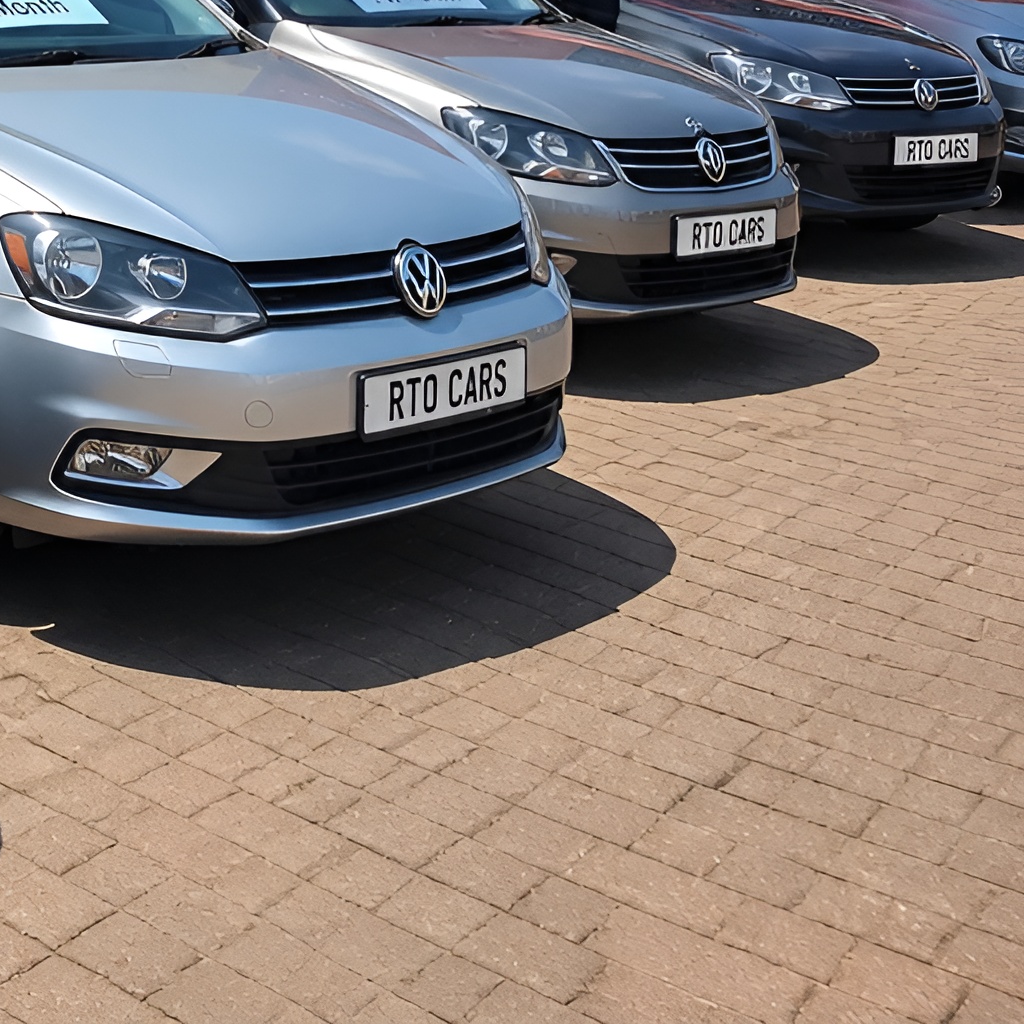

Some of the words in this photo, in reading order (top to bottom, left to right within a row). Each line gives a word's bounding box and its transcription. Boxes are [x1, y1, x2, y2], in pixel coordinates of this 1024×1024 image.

[906, 139, 932, 163] RTO
[692, 220, 723, 251] RTO
[388, 373, 438, 422] RTO
[448, 358, 507, 408] CARS
